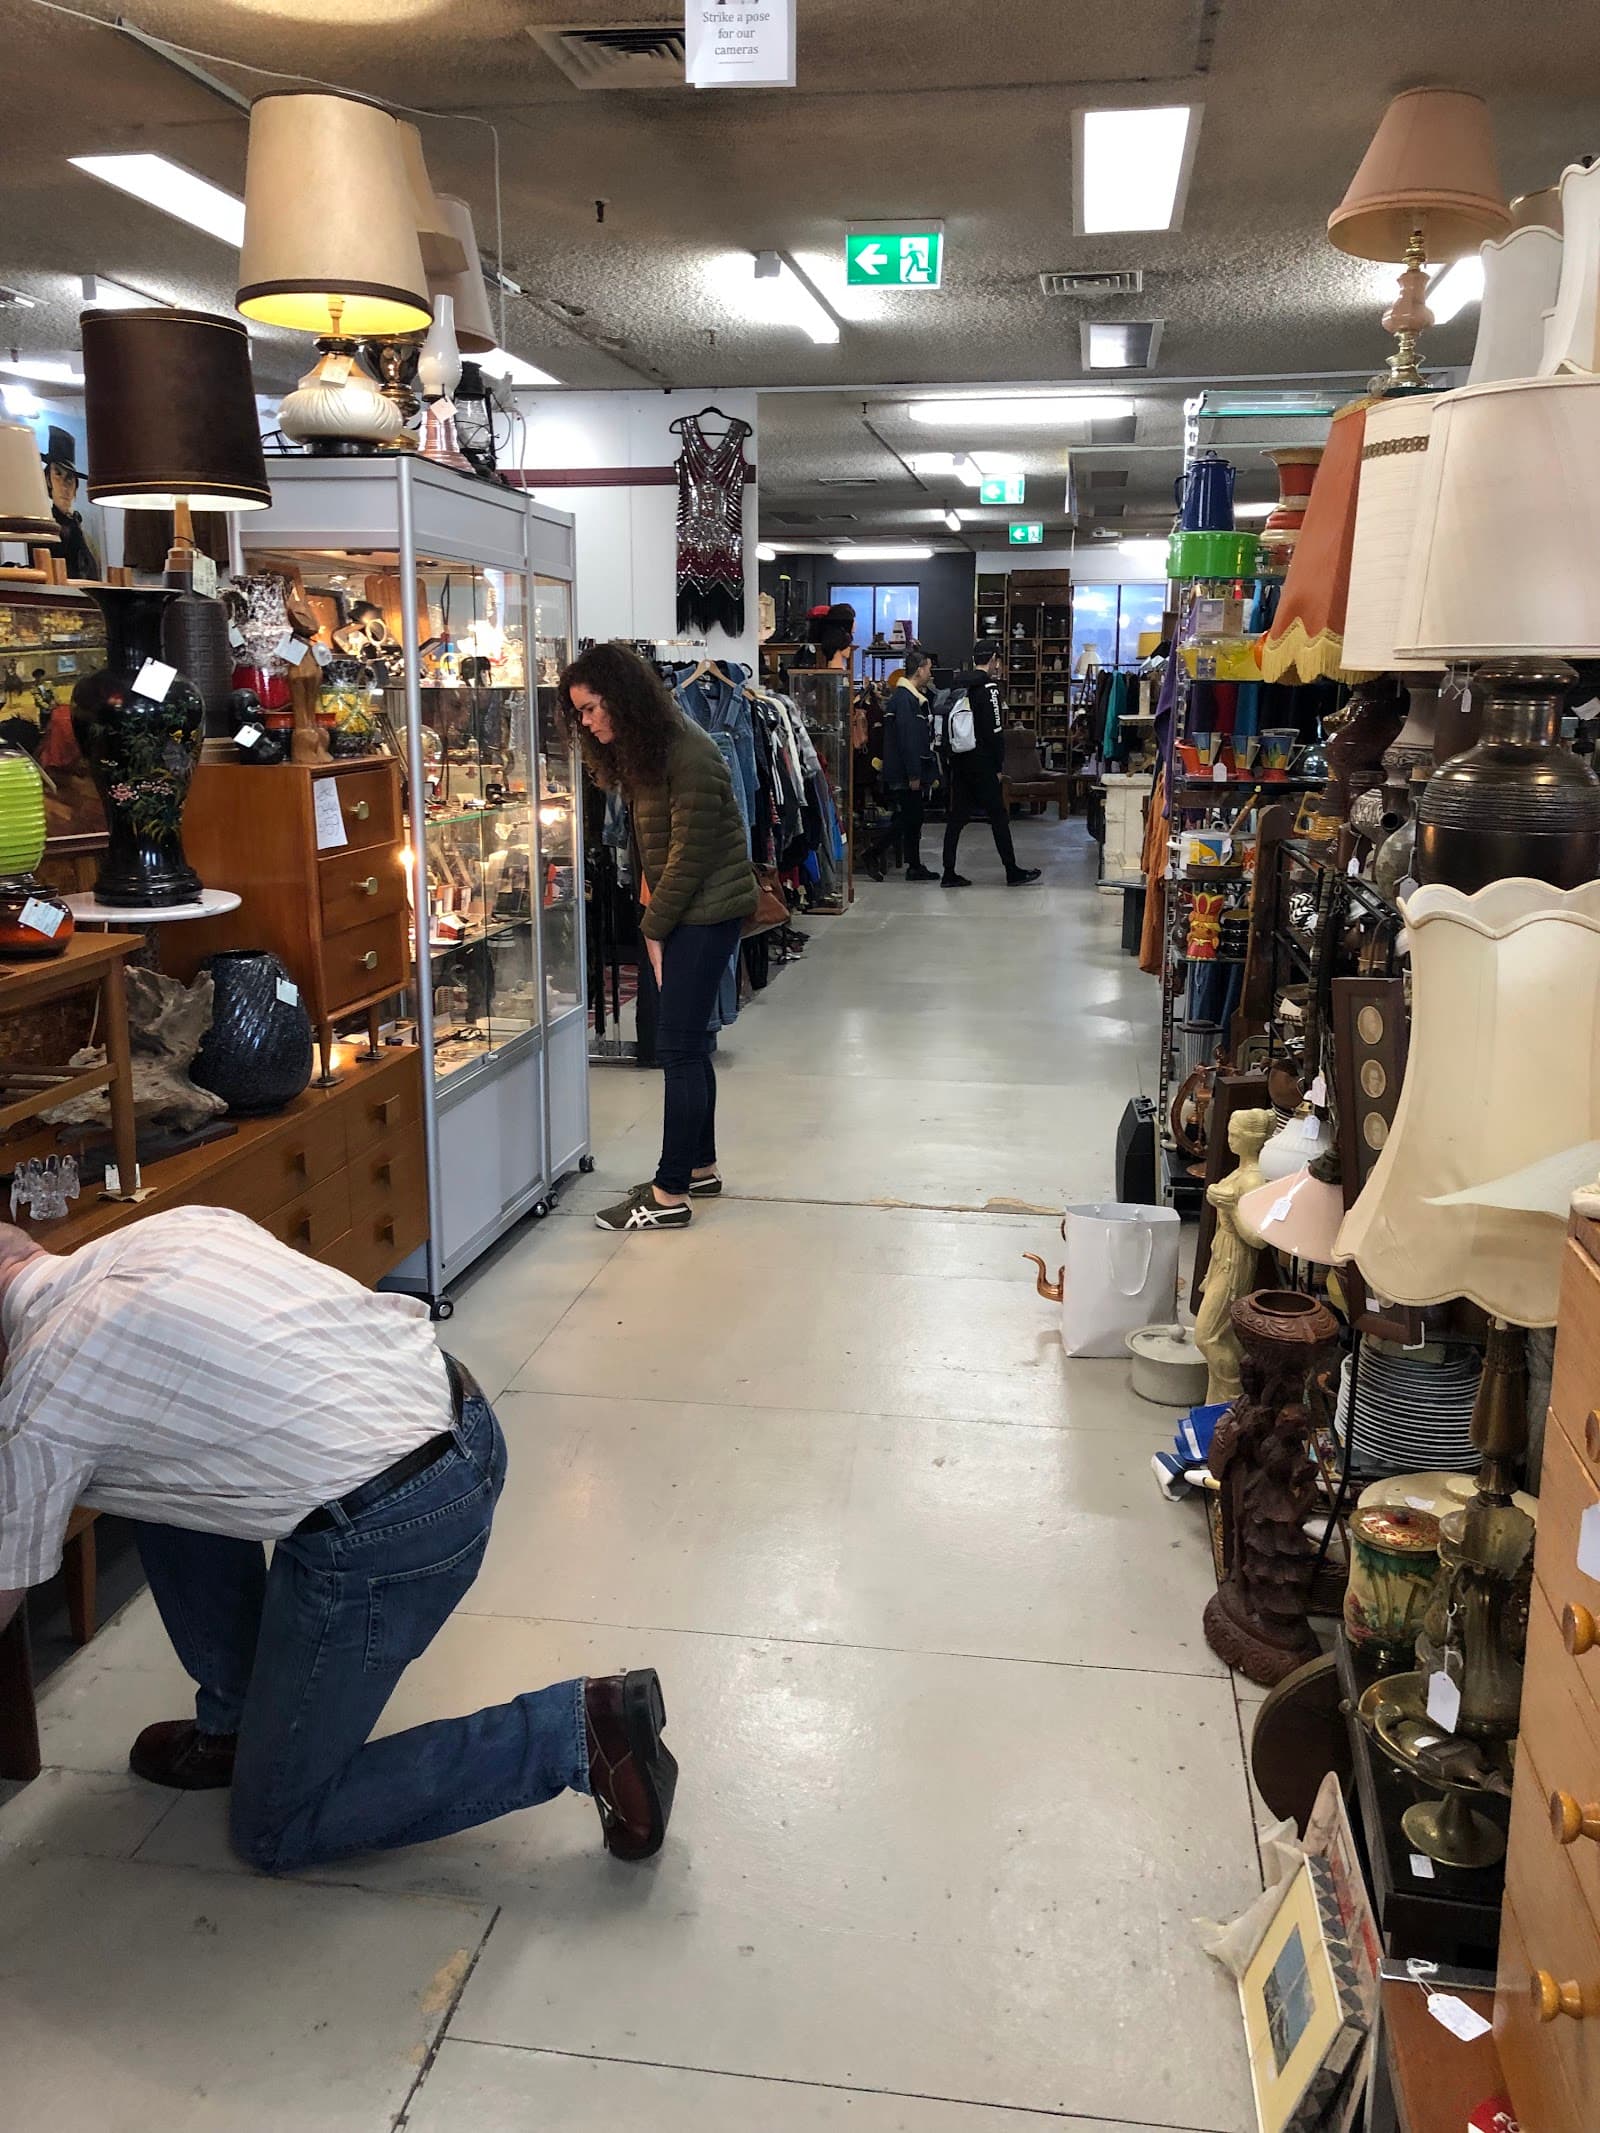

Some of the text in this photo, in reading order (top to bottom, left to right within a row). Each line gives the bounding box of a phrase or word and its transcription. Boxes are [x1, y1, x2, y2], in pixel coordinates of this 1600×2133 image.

[703, 11, 734, 23] Strike
[745, 12, 770, 24] pose
[718, 28, 756, 39] for our
[714, 45, 759, 55] cameras
[990, 689, 1000, 726] Supreme
